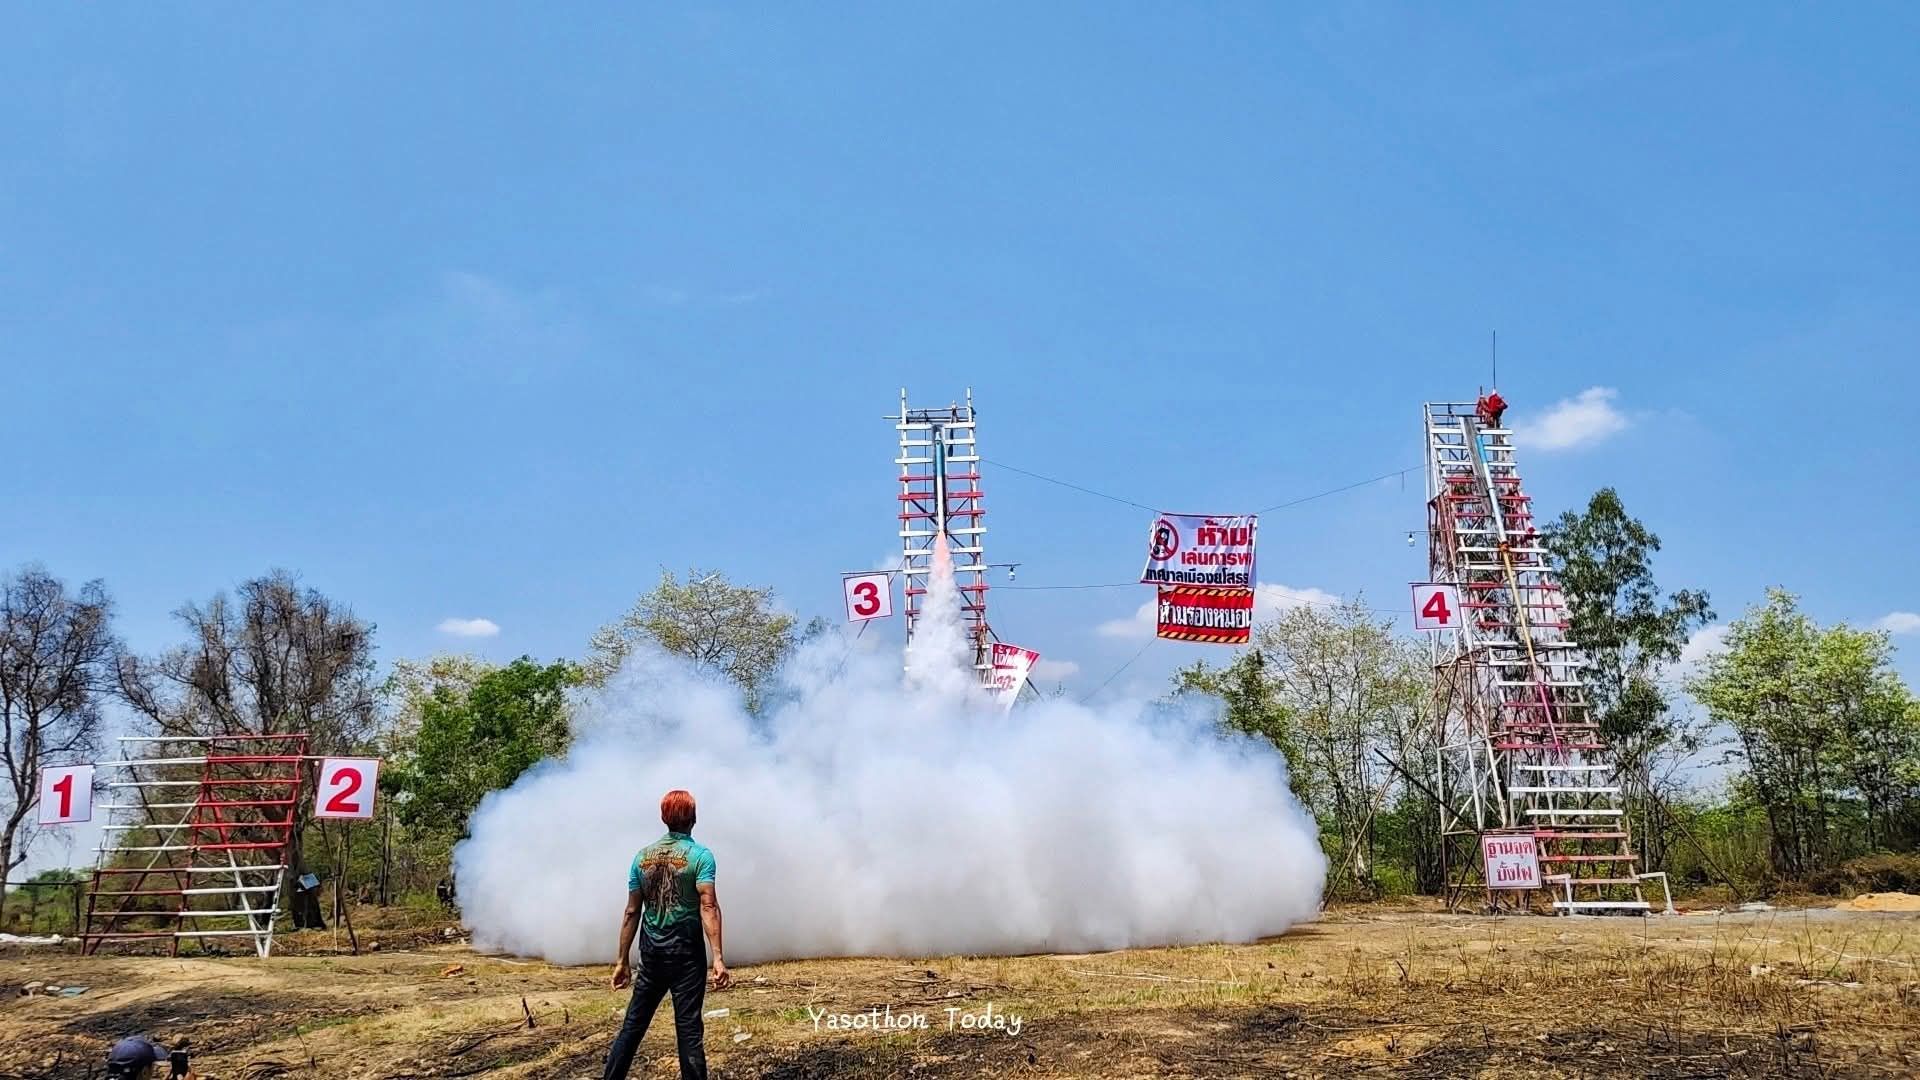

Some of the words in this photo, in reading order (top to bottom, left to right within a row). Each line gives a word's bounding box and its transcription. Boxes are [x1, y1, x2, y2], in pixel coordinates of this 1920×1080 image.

[854, 582, 881, 615] 3
[1422, 591, 1452, 625] 4
[53, 774, 73, 818] 1
[325, 767, 363, 814] 2
